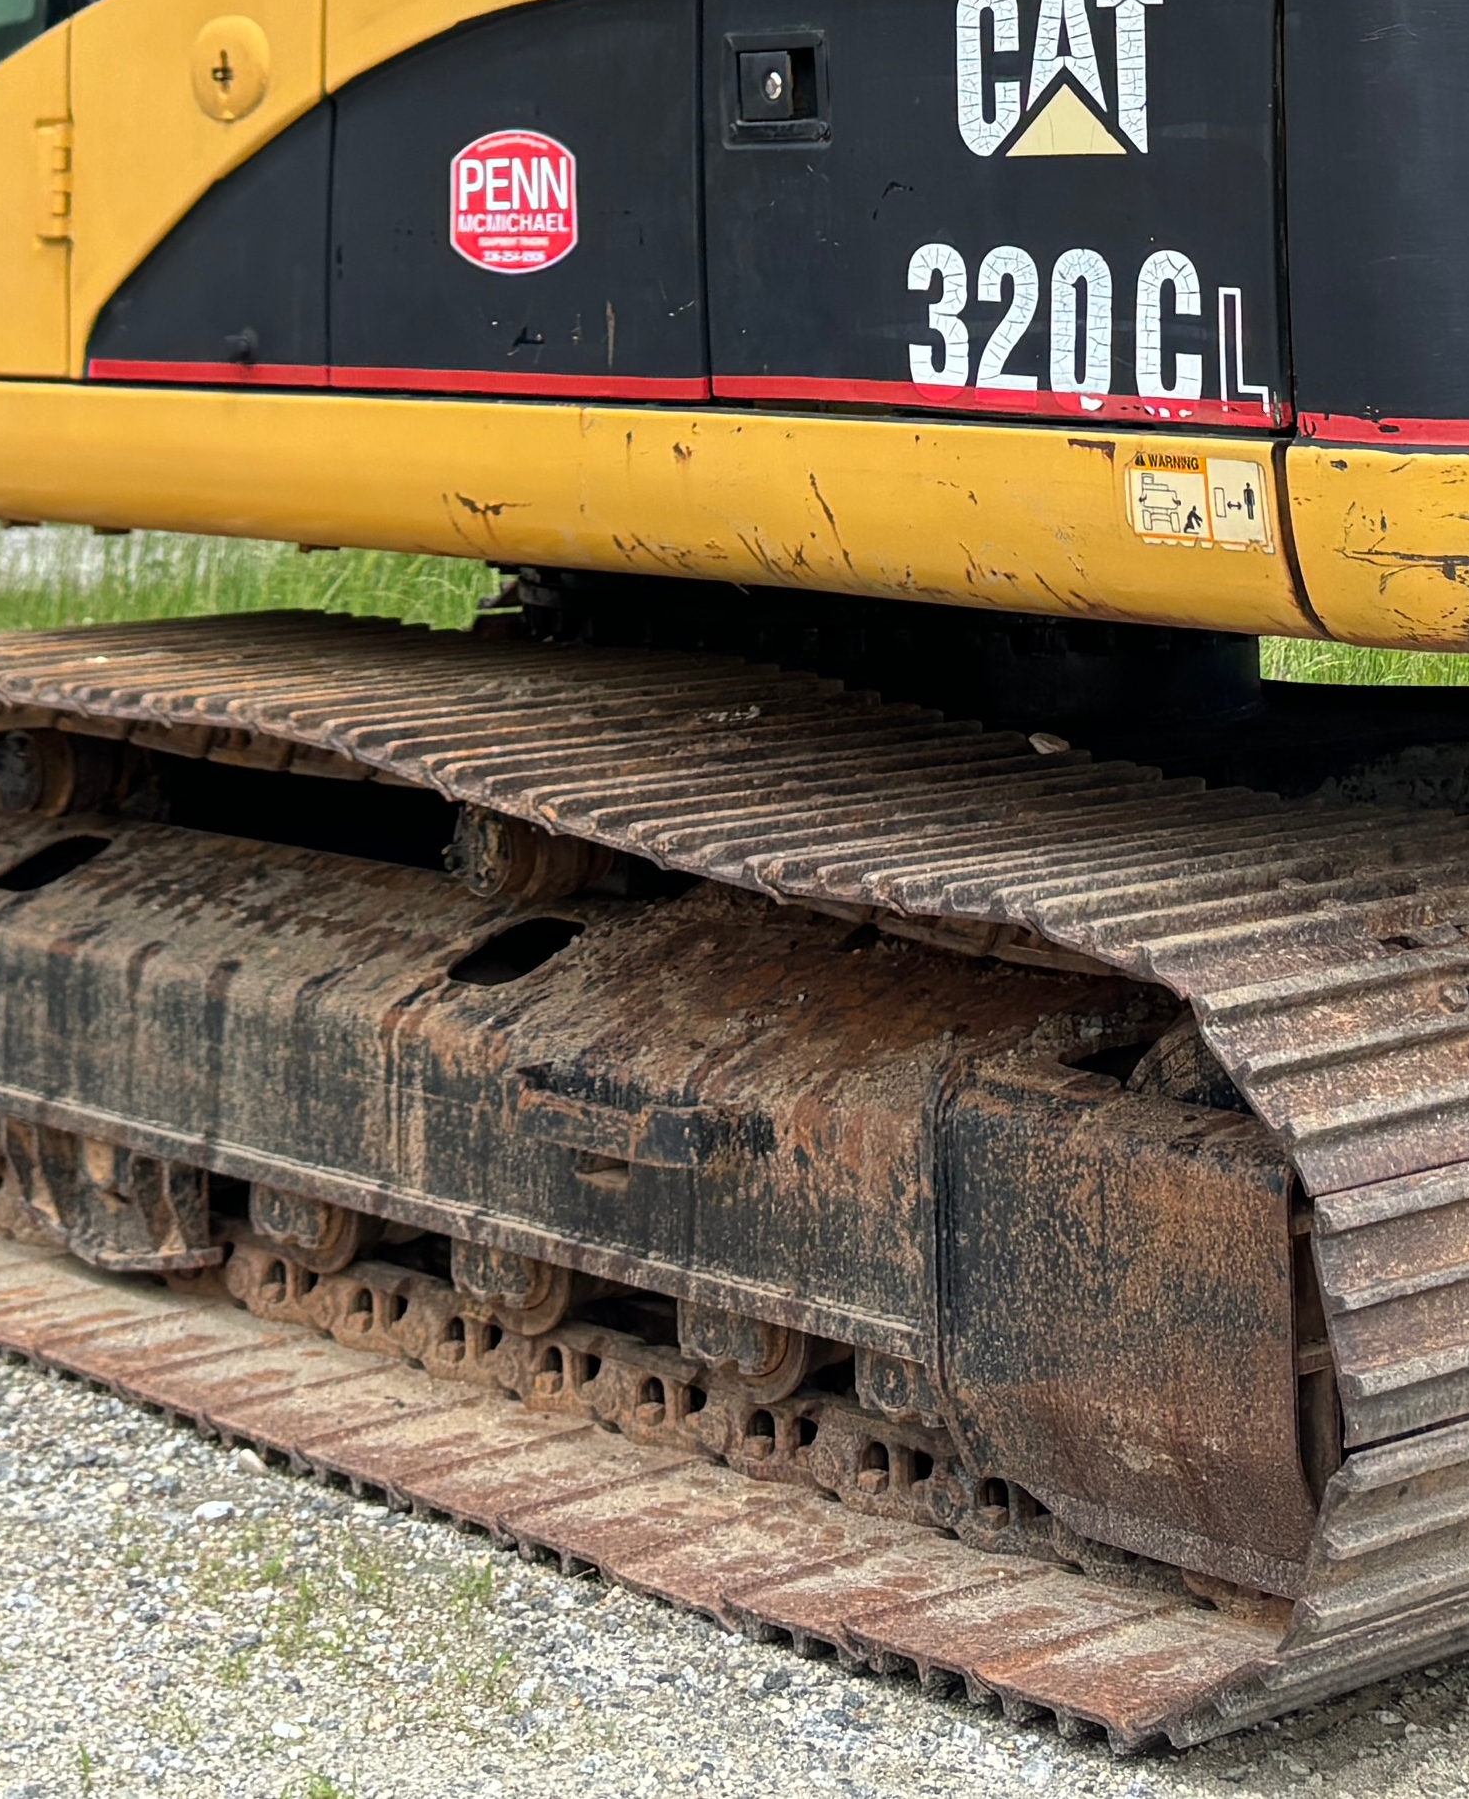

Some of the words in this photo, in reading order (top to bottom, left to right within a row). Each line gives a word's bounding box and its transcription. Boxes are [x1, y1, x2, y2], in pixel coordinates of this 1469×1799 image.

[459, 156, 568, 211] PENN
[457, 213, 569, 232] MCMICHAEL
[1148, 453, 1199, 470] WARNING
